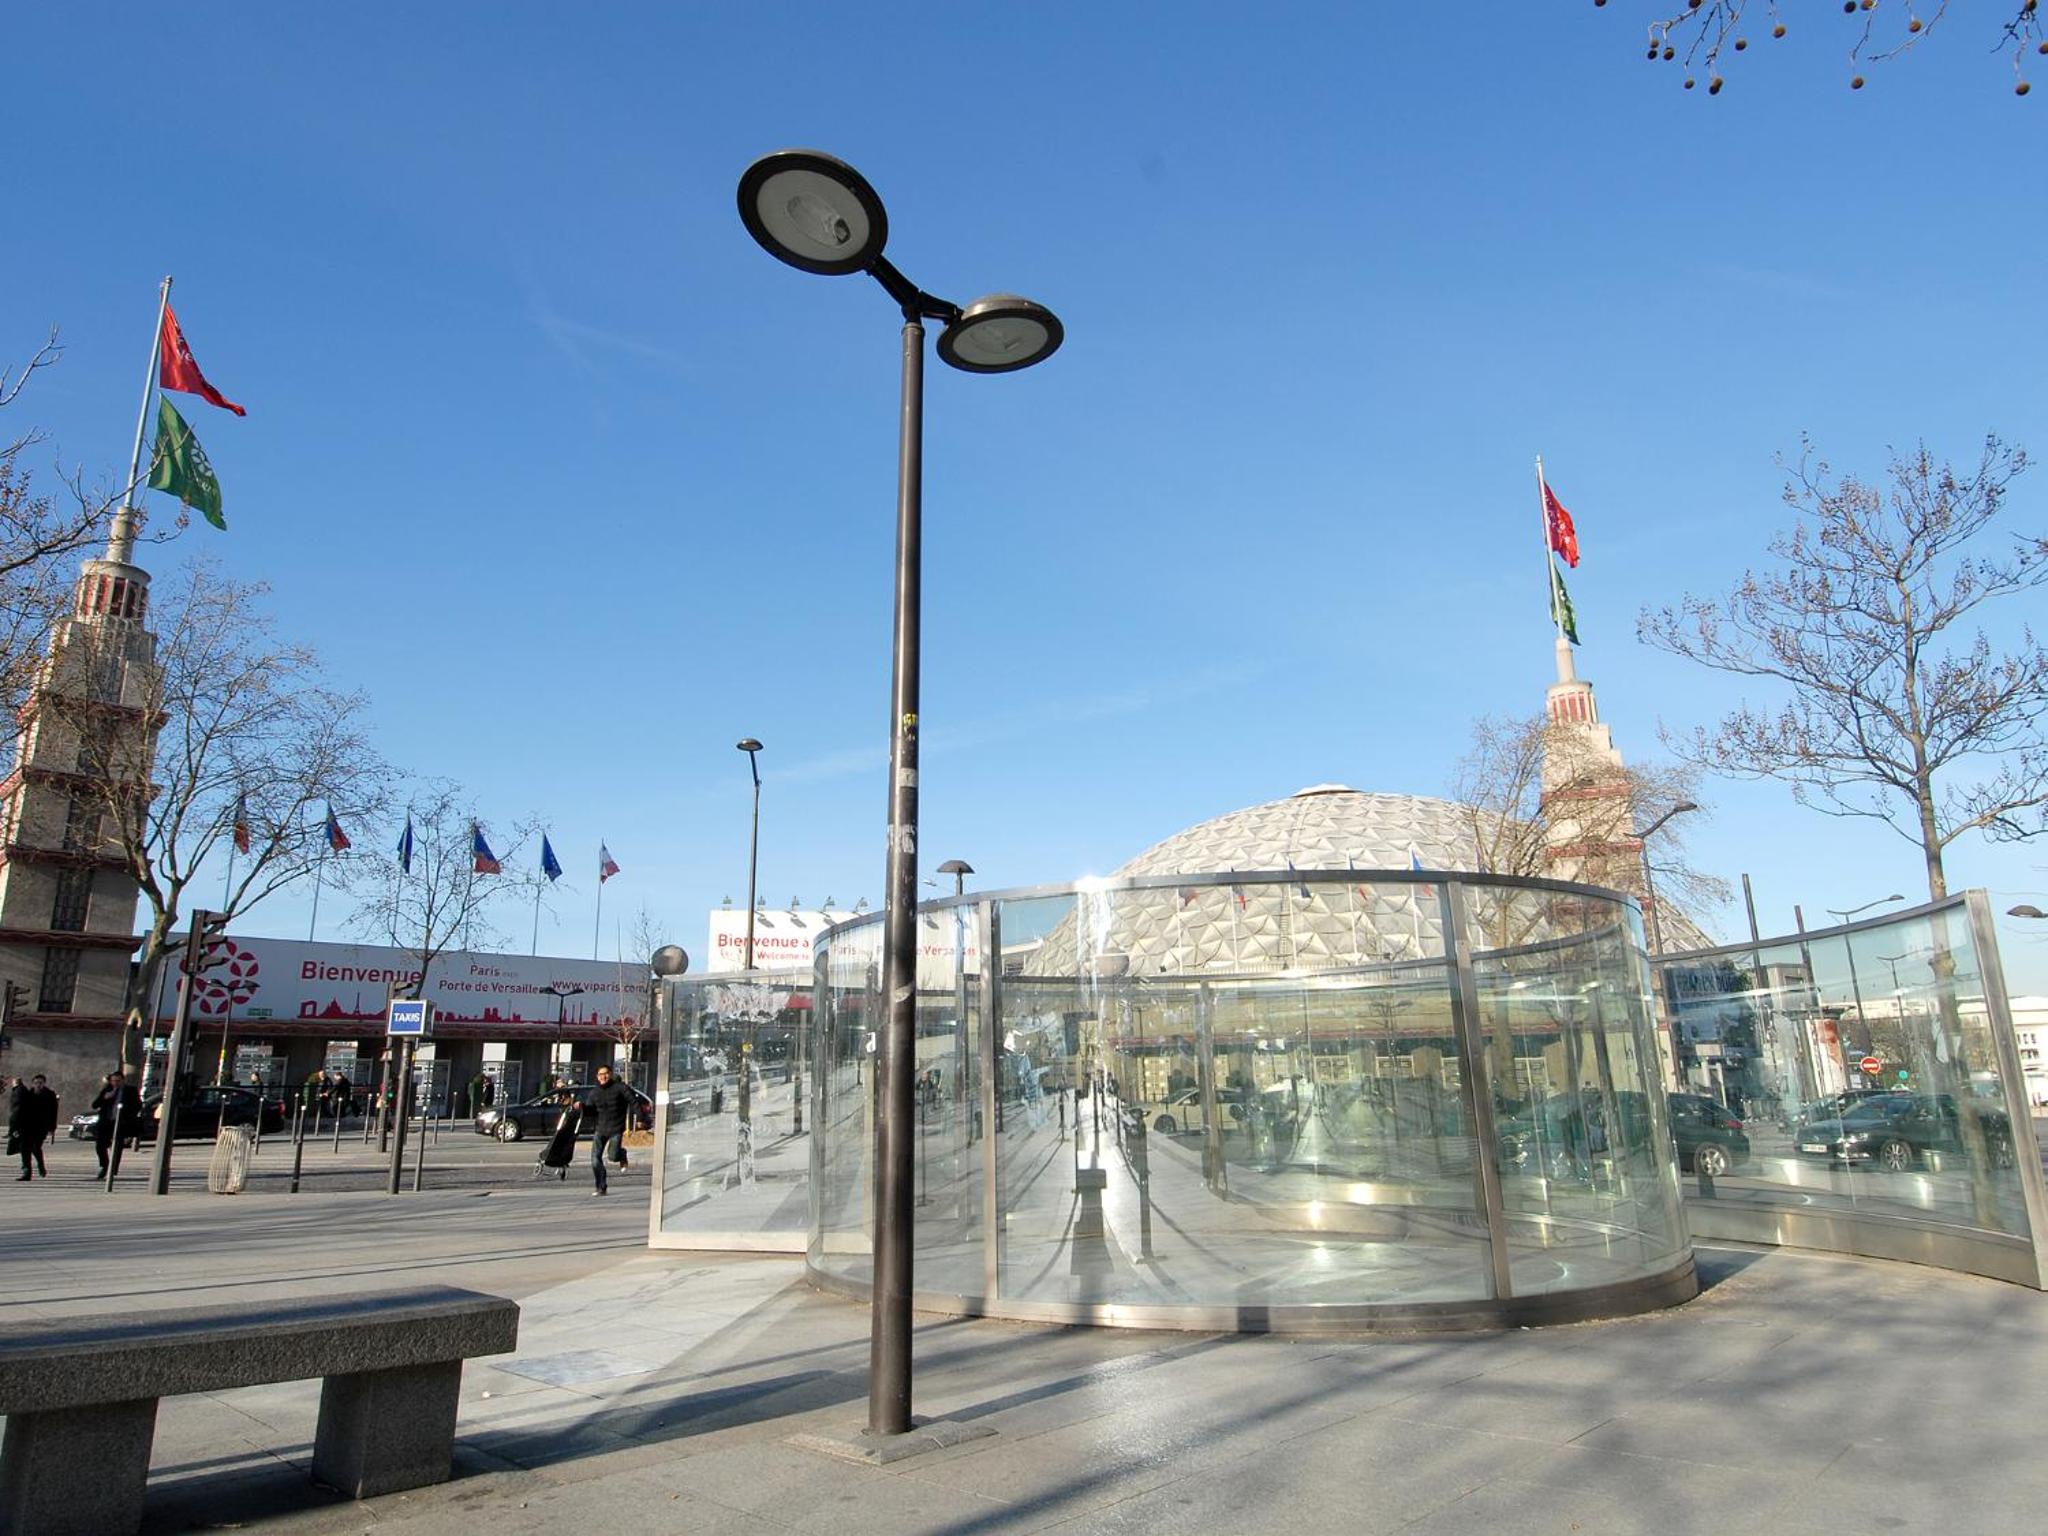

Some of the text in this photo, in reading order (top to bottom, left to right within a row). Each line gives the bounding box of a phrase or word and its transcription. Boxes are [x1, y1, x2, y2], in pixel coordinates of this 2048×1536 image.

[301, 960, 422, 984] Bienvenue
[470, 964, 500, 977] Paris
[439, 980, 472, 992] Porte
[475, 980, 489, 992] de
[394, 1012, 420, 1022] TAXIS
